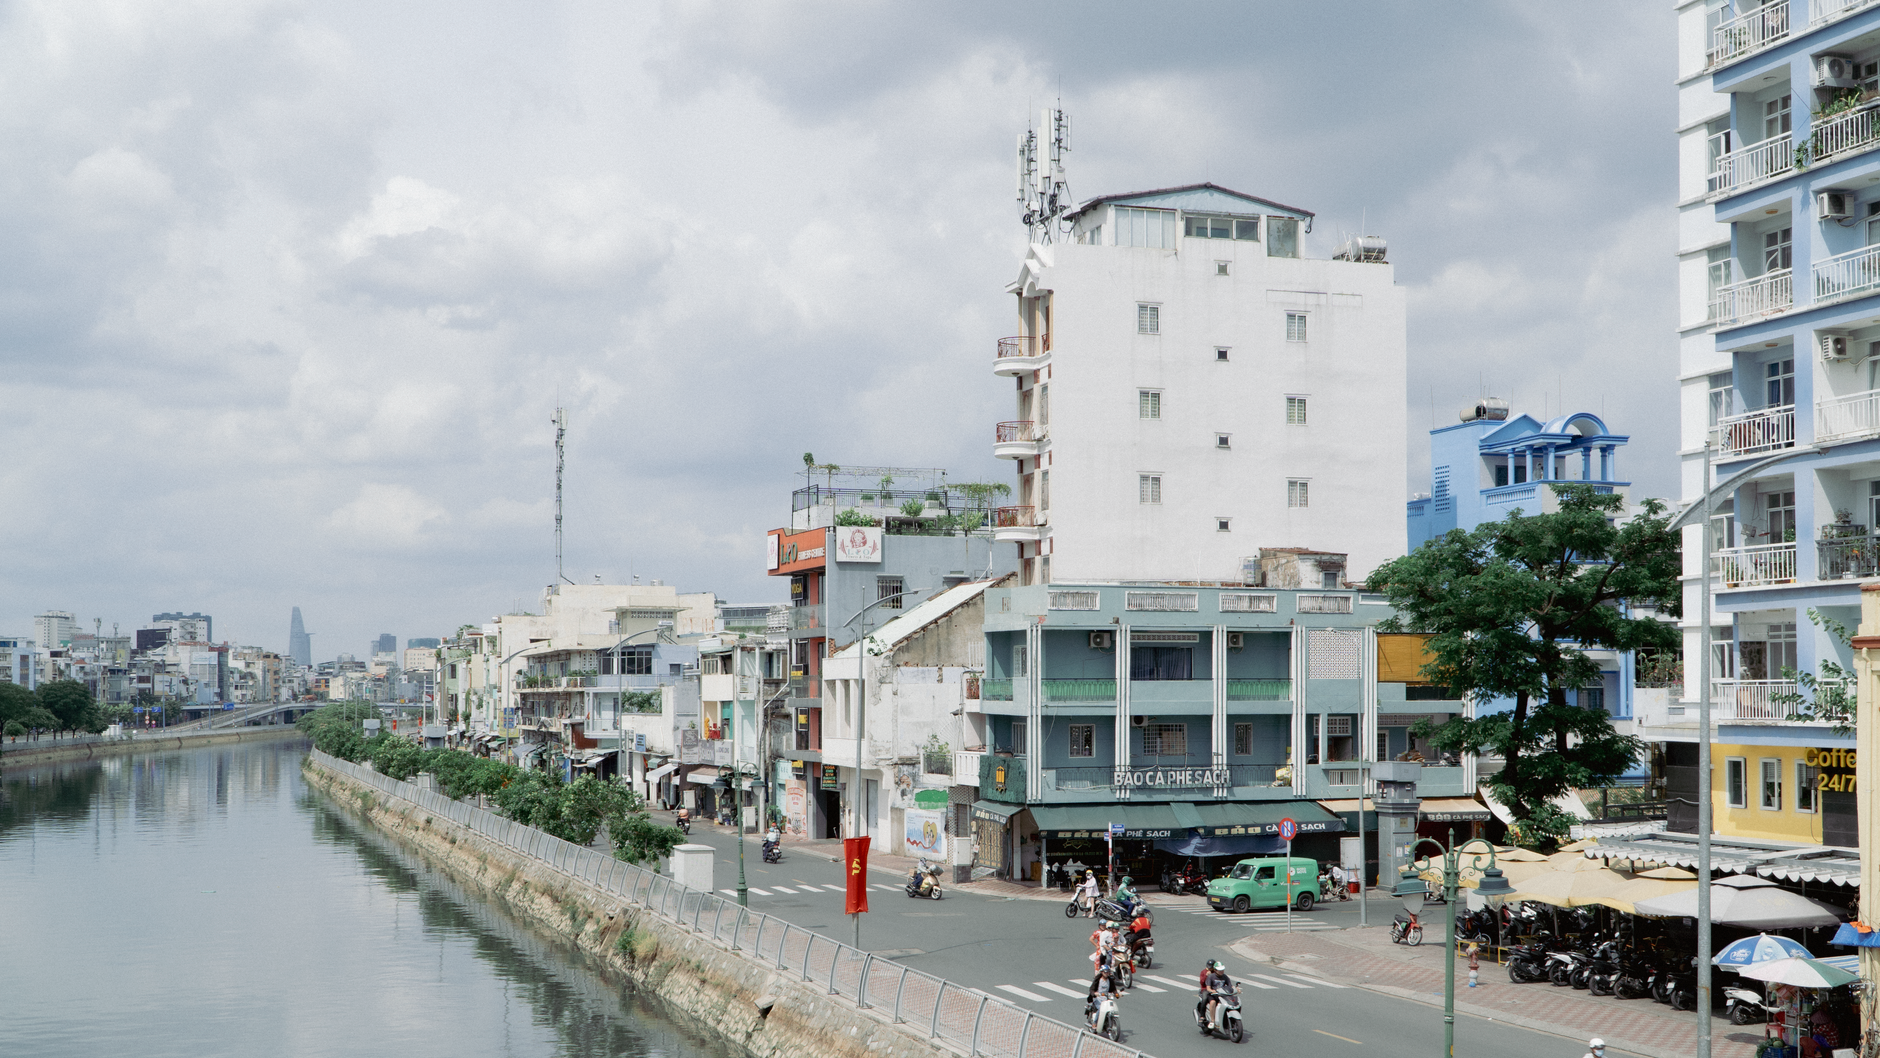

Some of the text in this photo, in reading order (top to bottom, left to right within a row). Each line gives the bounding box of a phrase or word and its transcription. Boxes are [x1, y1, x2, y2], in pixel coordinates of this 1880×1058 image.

[791, 582, 802, 594] YOGA
[1167, 767, 1193, 784] PHÊ
[1194, 770, 1230, 786] SẠCH
[1818, 774, 1856, 792] 24/7
[1301, 823, 1326, 832] SẠCH
